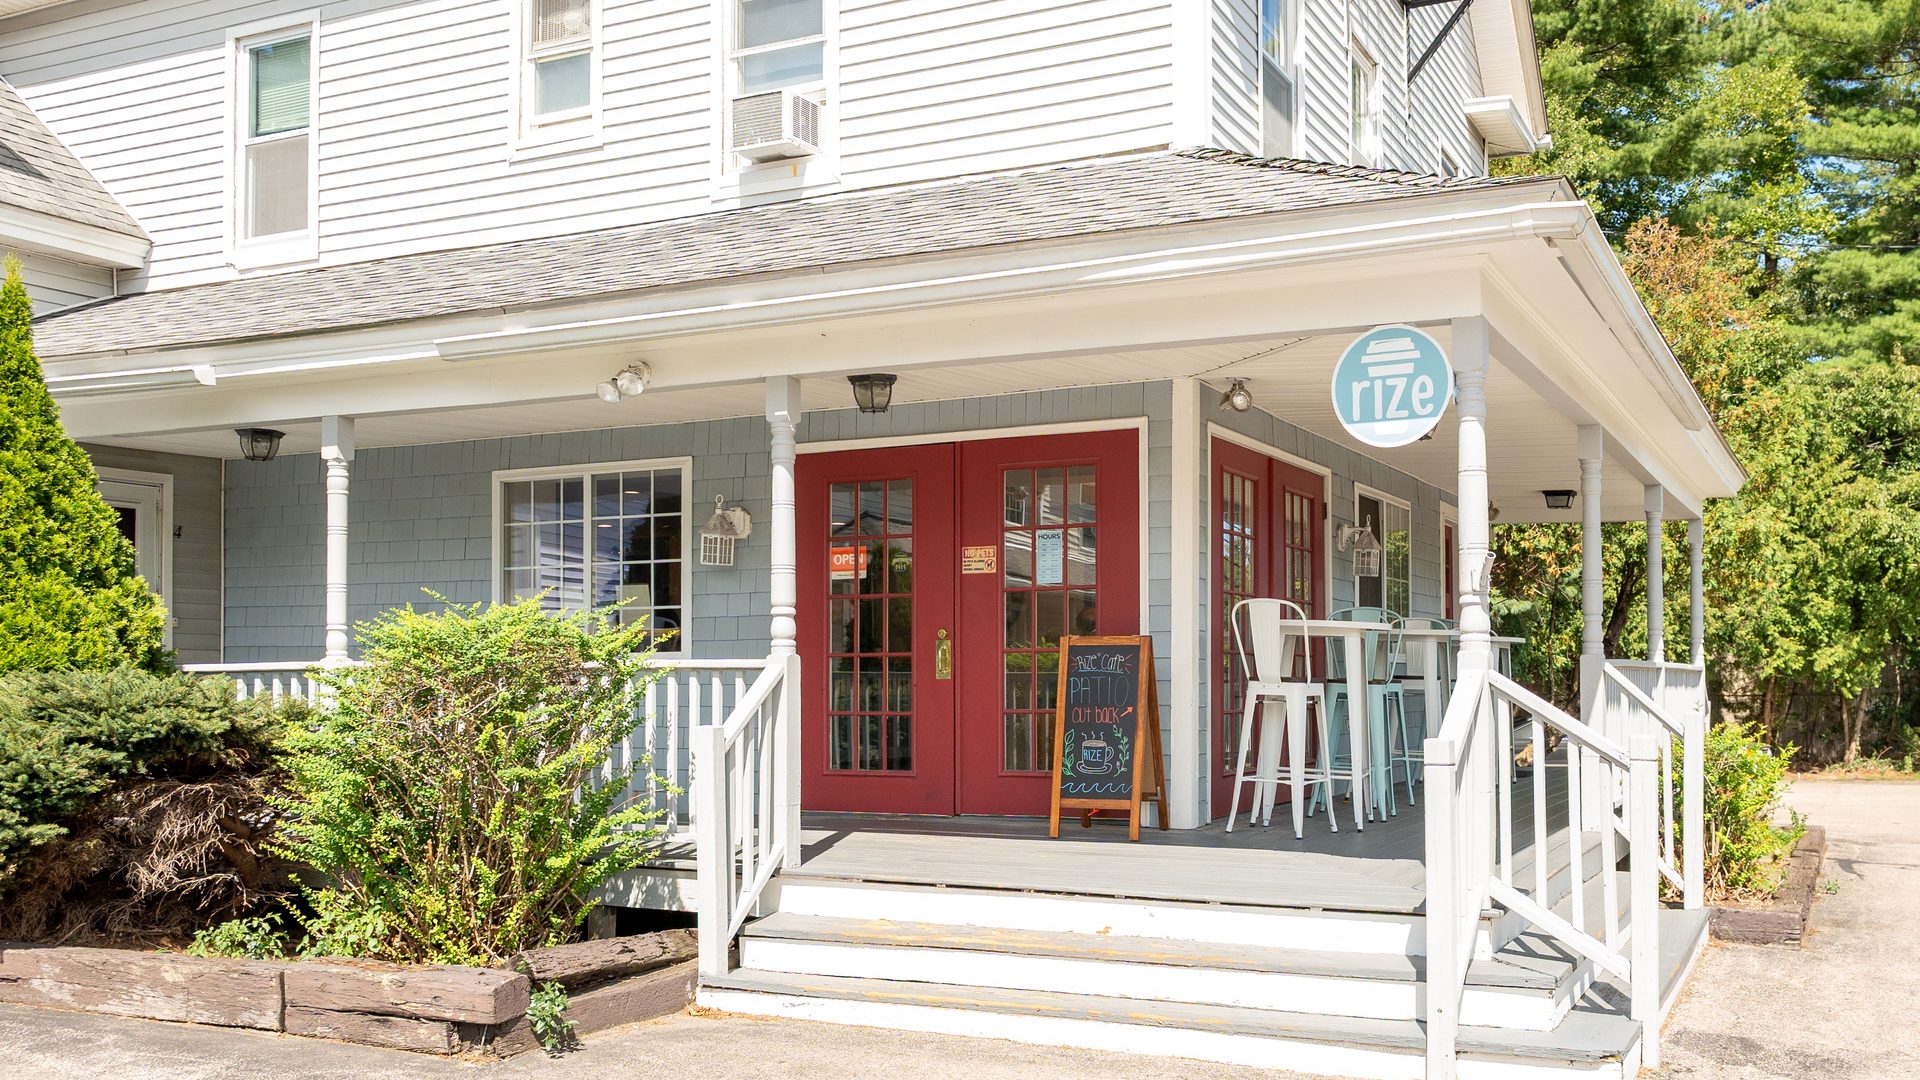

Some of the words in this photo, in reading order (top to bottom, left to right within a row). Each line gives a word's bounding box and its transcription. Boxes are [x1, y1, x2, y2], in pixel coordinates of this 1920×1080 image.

[1351, 374, 1434, 422] rize
[173, 525, 182, 539] 4
[964, 549, 975, 558] NO
[977, 548, 994, 557] PETS
[1070, 676, 1130, 707] PATIO
[1095, 705, 1120, 723] back
[1083, 749, 1103, 761] RIZE
